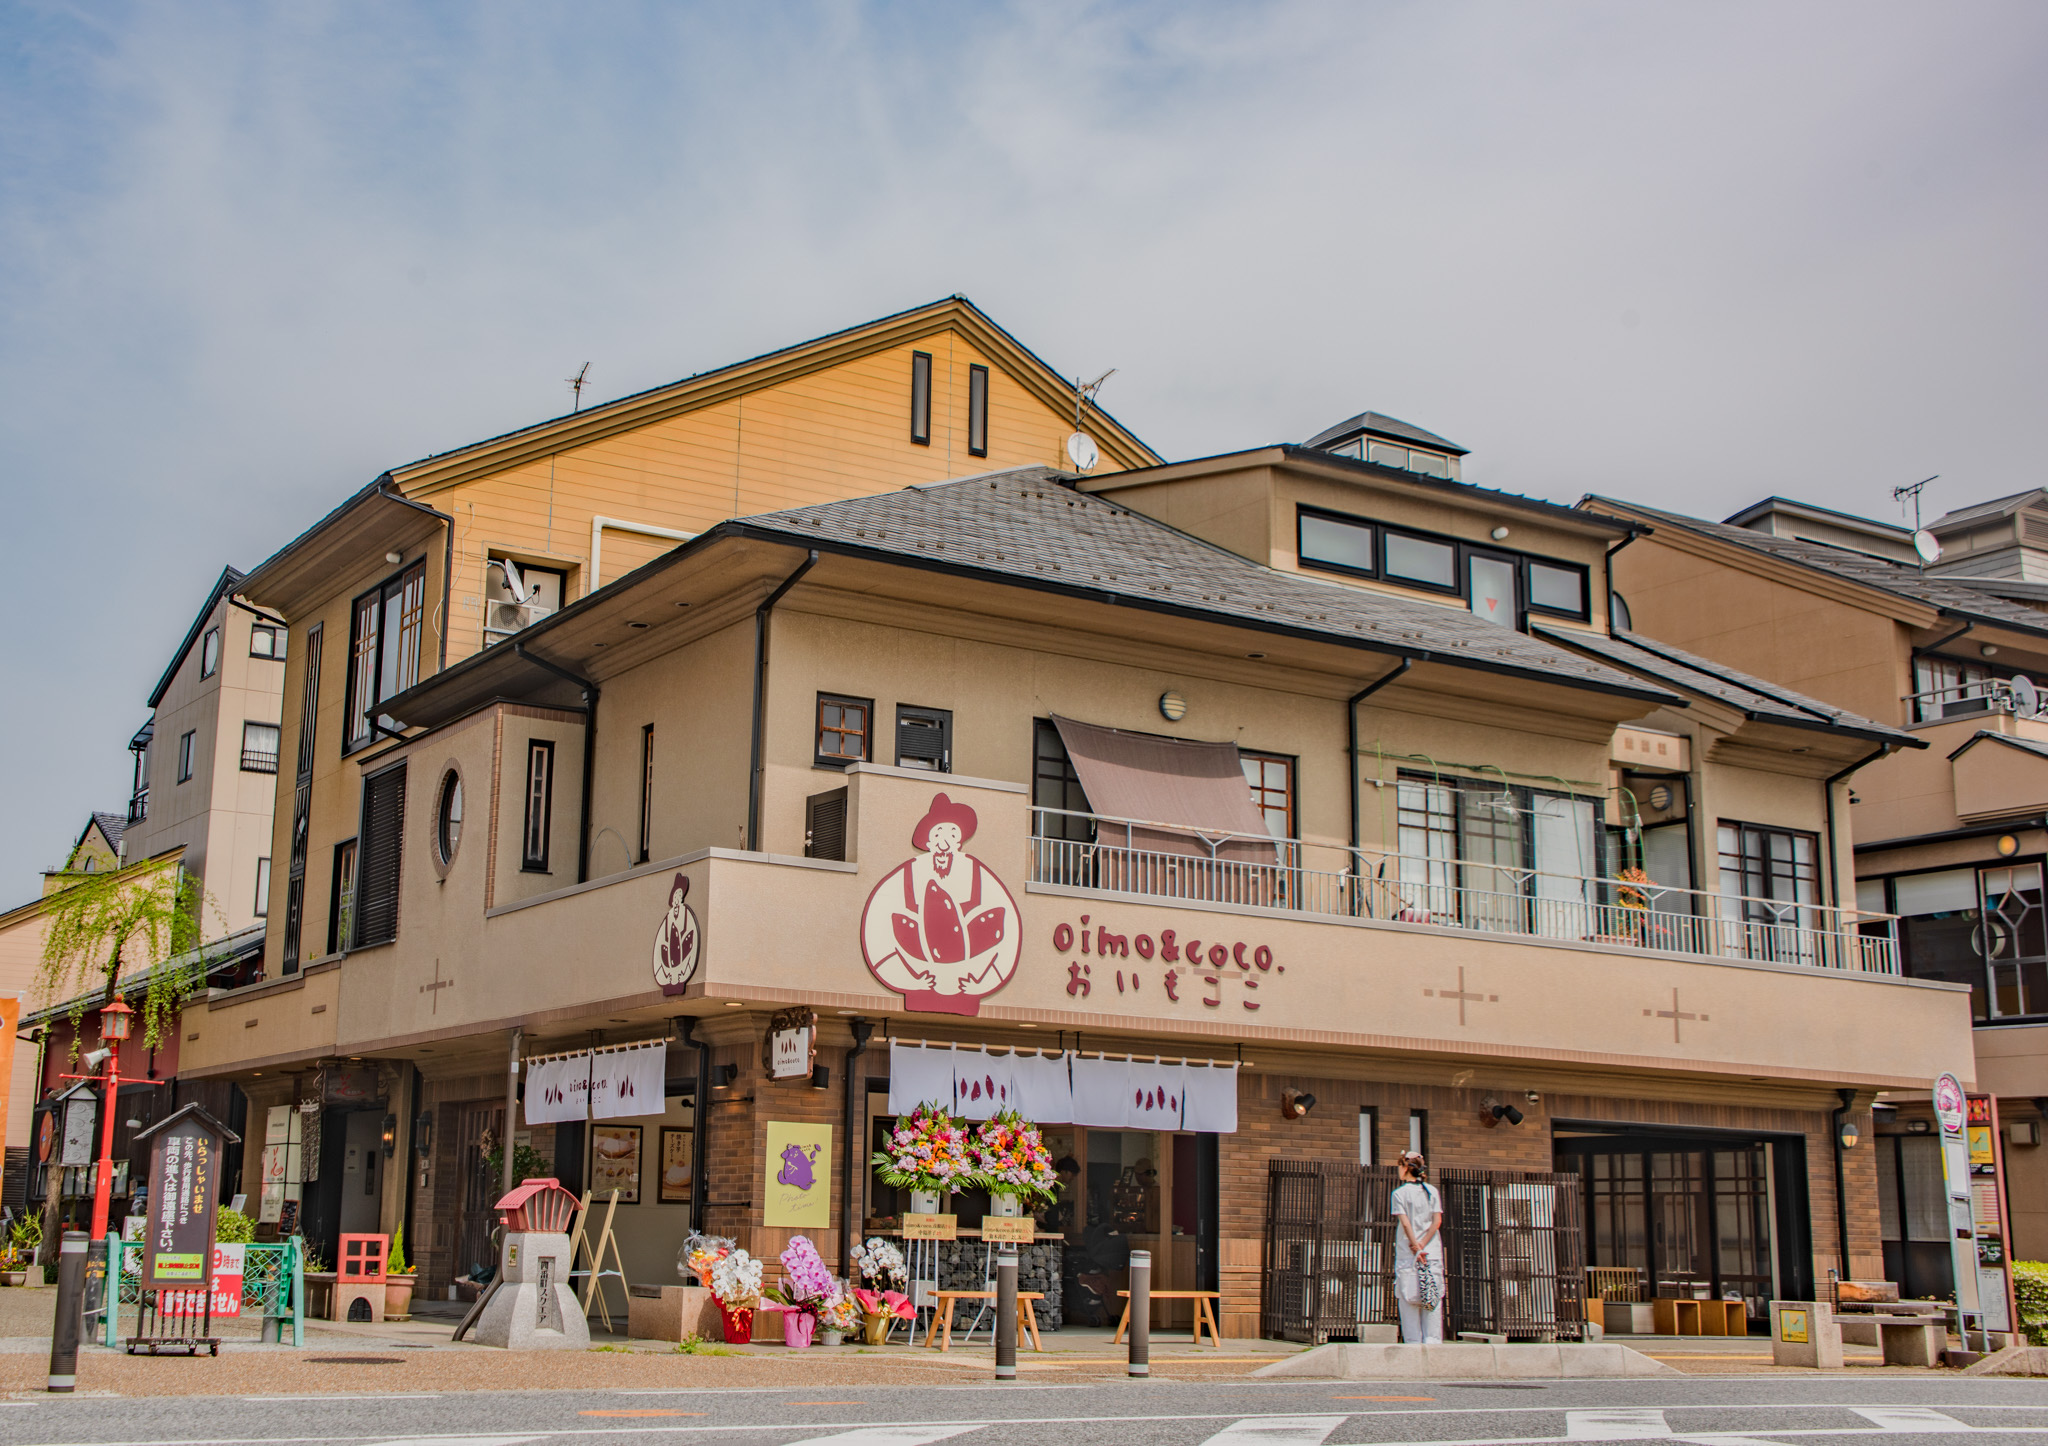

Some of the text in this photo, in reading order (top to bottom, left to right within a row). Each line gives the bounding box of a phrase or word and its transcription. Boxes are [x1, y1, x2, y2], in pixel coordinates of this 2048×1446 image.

[1053, 914, 1285, 972] oimo&coco.
[1066, 960, 1261, 1010] おいもここ
[159, 1136, 182, 1253] 車両の進入は御遠慮下さい。
[193, 1137, 208, 1214] いらっしゃいませ
